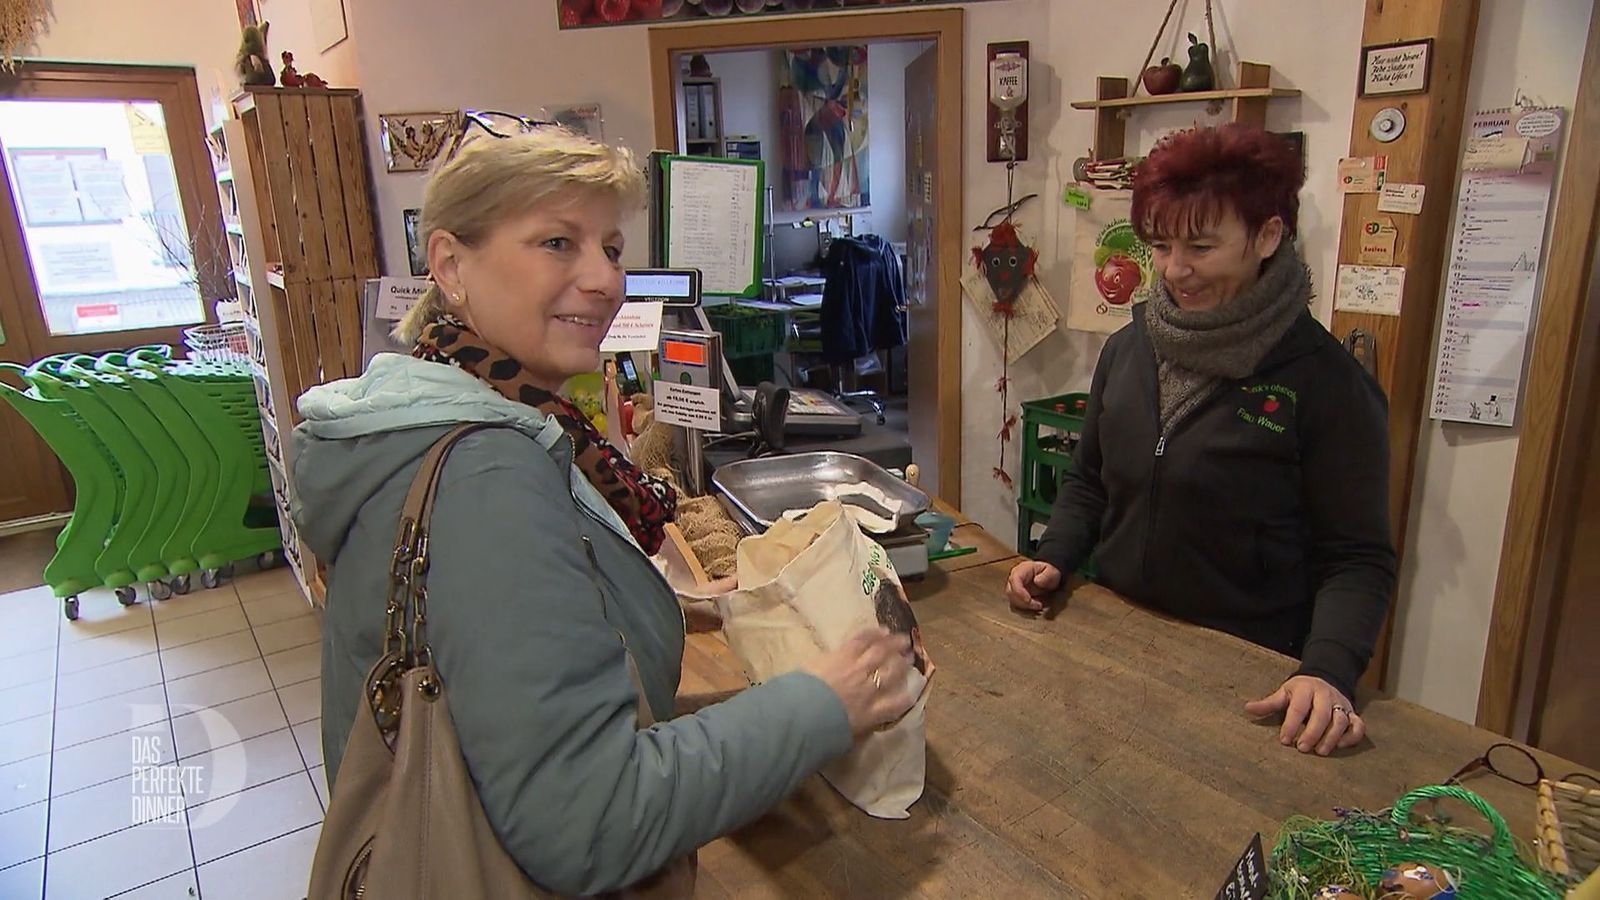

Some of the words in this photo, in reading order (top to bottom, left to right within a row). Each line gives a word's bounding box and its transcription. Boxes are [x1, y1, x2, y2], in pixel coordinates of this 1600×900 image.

[1000, 76, 1018, 86] KAFFEE
[1474, 120, 1510, 128] FEBRUAR
[1237, 408, 1254, 422] Frau
[1258, 416, 1285, 433] Wauer
